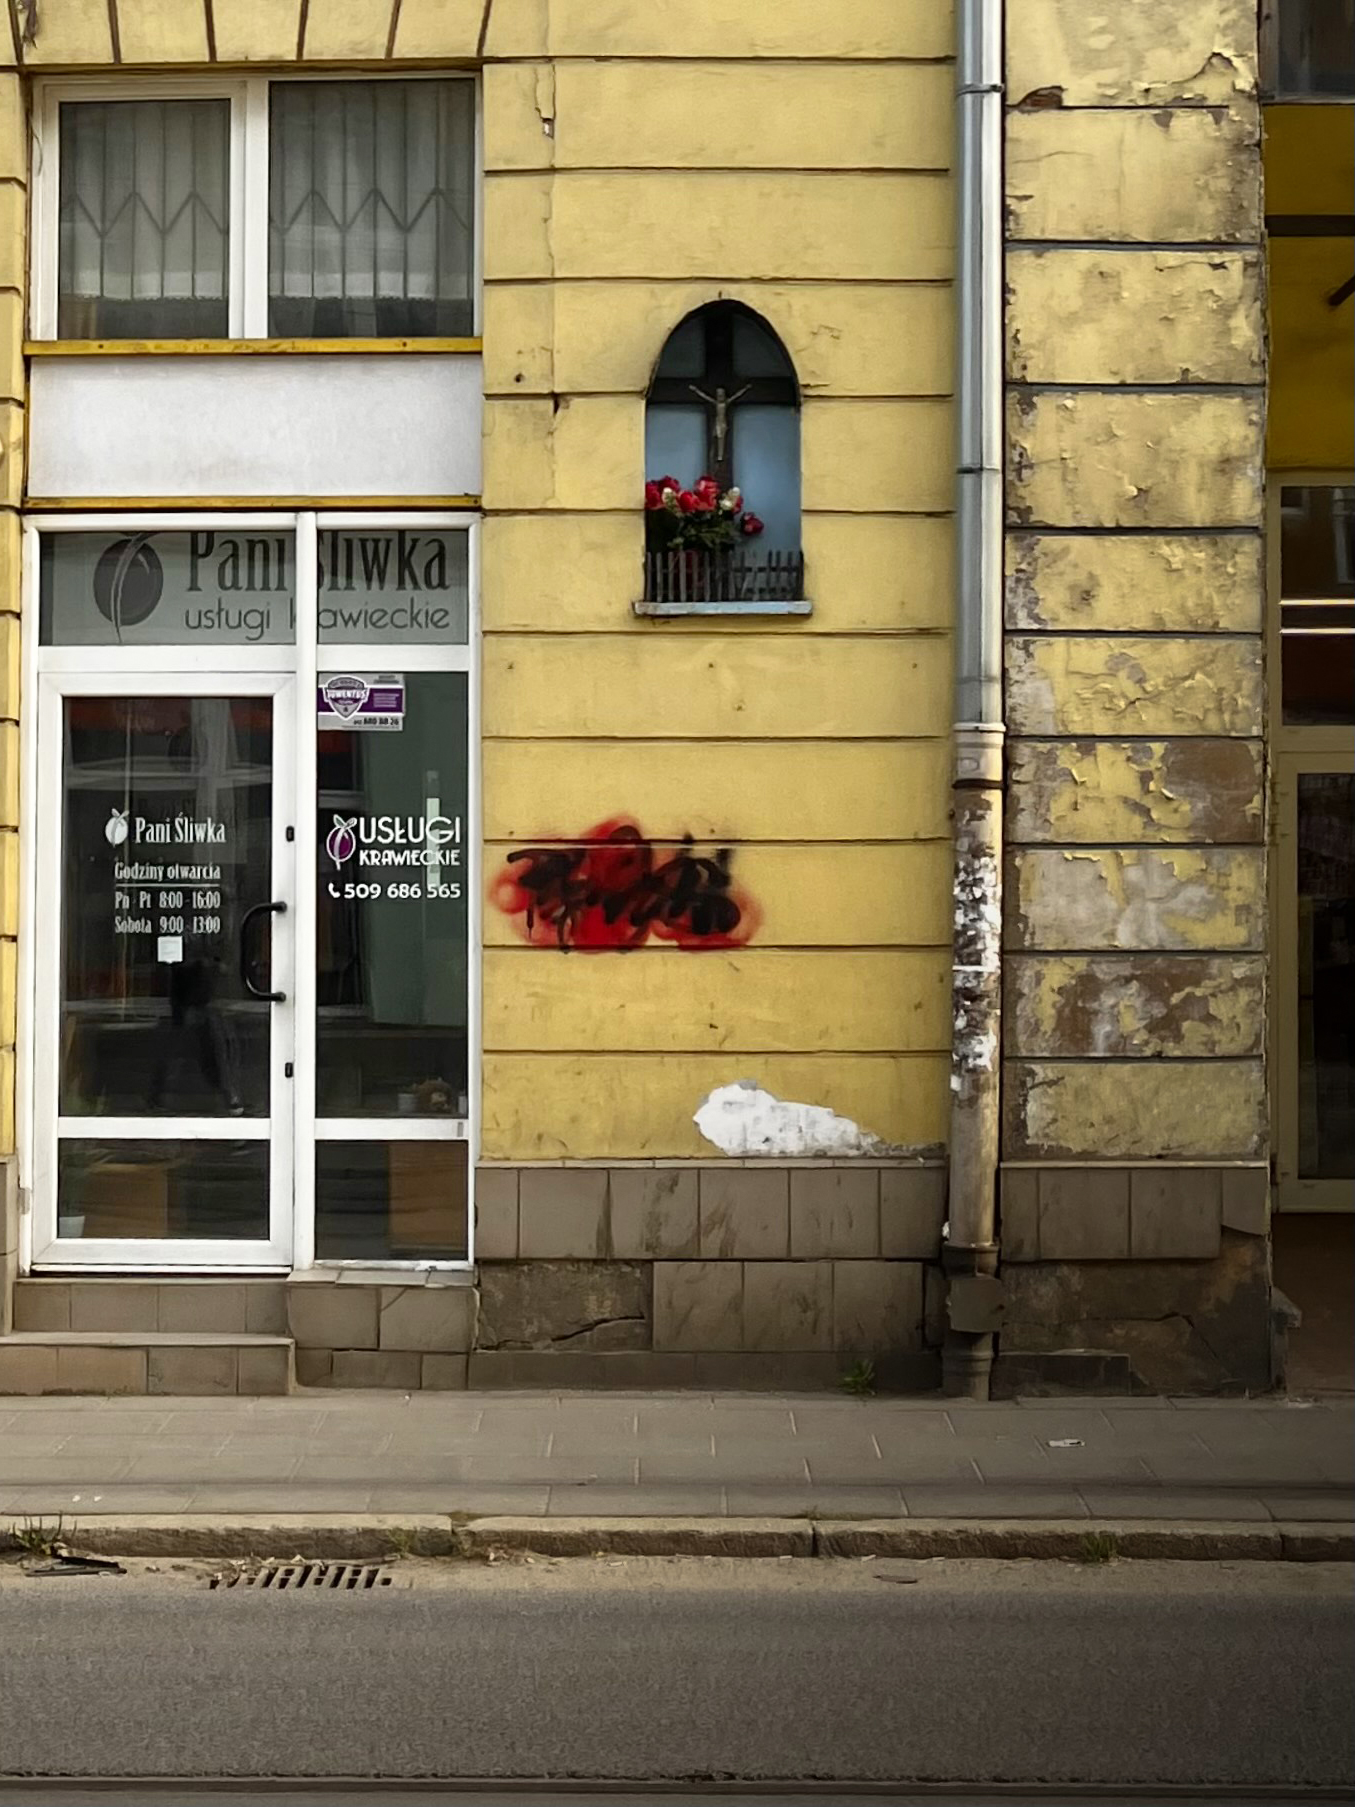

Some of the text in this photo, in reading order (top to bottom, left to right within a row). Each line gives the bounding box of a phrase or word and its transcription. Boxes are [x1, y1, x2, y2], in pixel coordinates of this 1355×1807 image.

[187, 532, 288, 591] Pani
[185, 596, 450, 641] usługi awieckie
[135, 812, 226, 843] Pani Śliwka
[359, 816, 461, 844] USŁUGI
[359, 849, 461, 866] KRAWIECKIE
[114, 861, 221, 882] Godziny otwarcia
[115, 892, 130, 909] Pn
[139, 891, 152, 908] Pt
[159, 891, 184, 908] 8:00
[192, 891, 221, 909] 16:00
[344, 883, 461, 899] 509 686 565
[115, 916, 152, 933] Sobota
[159, 916, 184, 933] 9:00
[192, 916, 221, 933] 13:00
